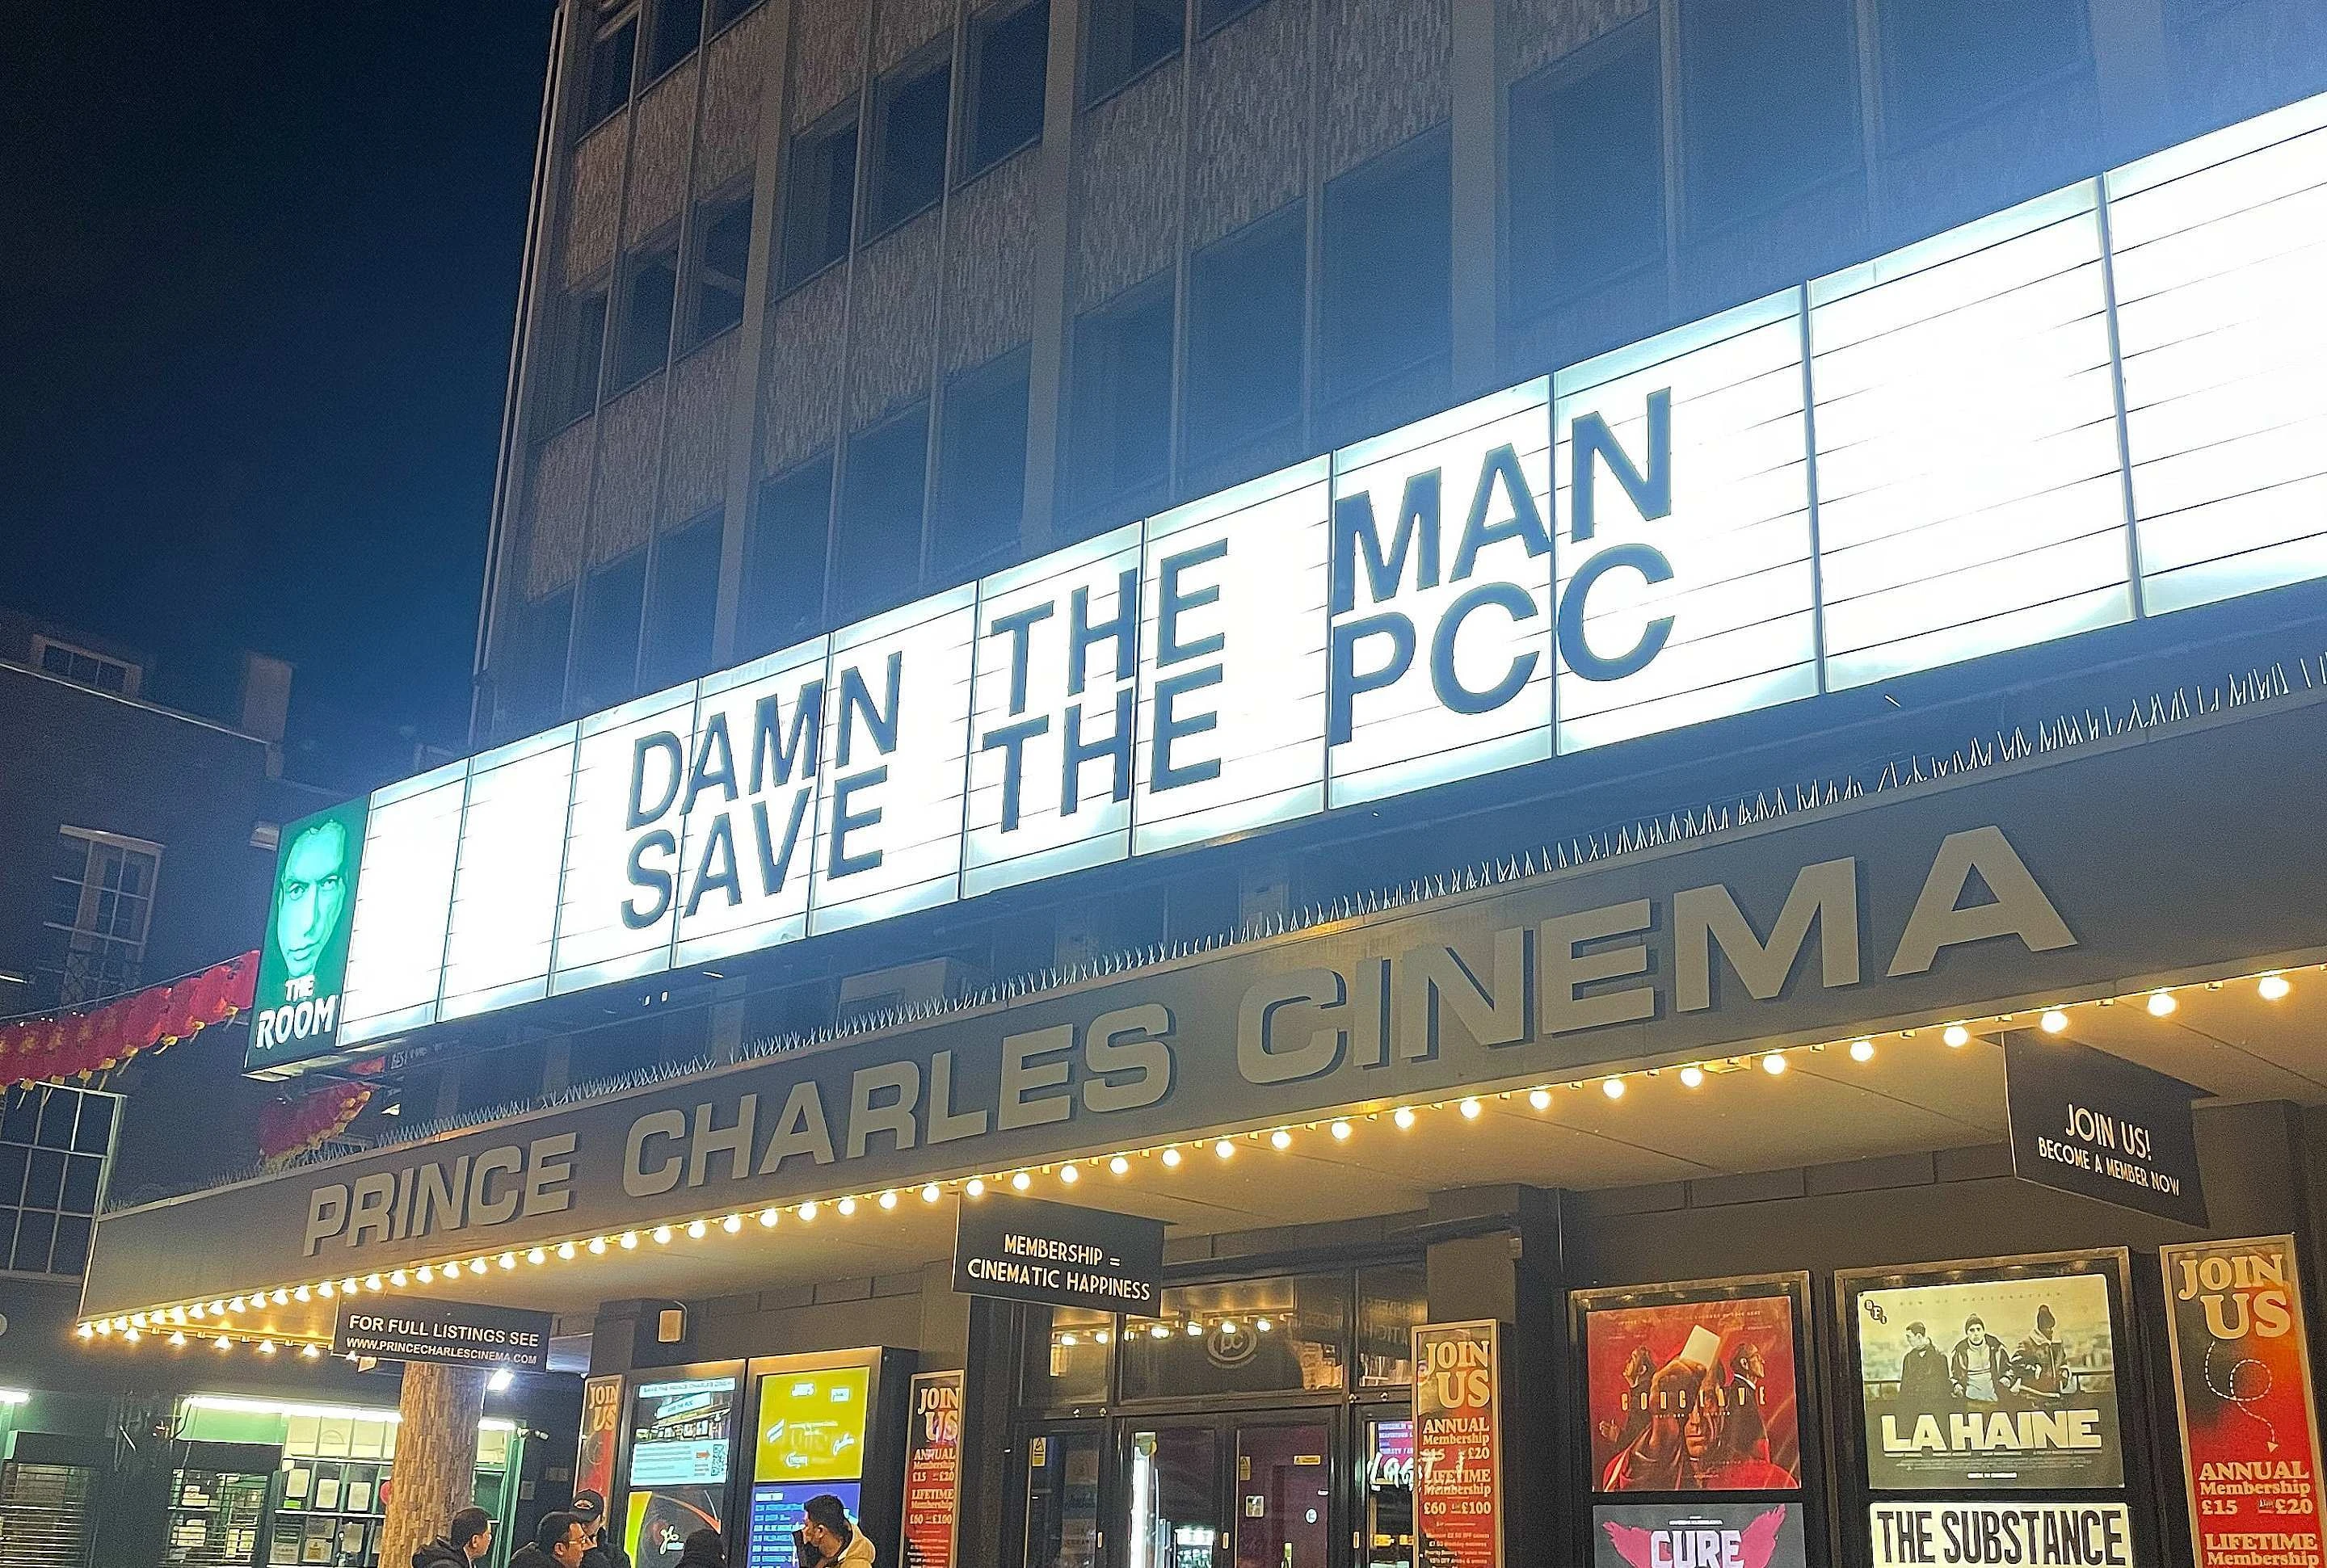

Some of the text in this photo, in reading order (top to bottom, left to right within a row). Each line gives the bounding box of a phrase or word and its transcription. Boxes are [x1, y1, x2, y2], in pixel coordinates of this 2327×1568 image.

[625, 386, 1672, 830] DAMN THE MAN
[621, 543, 1676, 929] SAVE THE PCC
[284, 974, 315, 1002] THE
[255, 994, 336, 1050] ROOM
[303, 825, 2078, 1257] PRINCE CHARLES CINEMA
[2065, 1103, 2152, 1162] JOIN US!
[2038, 1136, 2180, 1197] BECOME A MEMBER NOW
[1004, 1234, 1104, 1267] MEMBERSHIP
[967, 1258, 1151, 1301] CINEMATIC HAPPINESS
[2178, 1254, 2283, 1301] JOIN
[2199, 1290, 2291, 1340] US
[348, 1314, 540, 1347] FOR FULL LISTINGS SEE
[346, 1337, 537, 1364] WWW.PRINCECHARLESCINEMA.COM
[1417, 1340, 1490, 1386] JOIN
[589, 1383, 619, 1409] JOIN
[917, 1387, 961, 1415] JOIN
[1436, 1369, 1491, 1409] US
[593, 1406, 616, 1431] US
[924, 1410, 959, 1441] US
[1423, 1417, 1490, 1434] ANNUAL
[1881, 1409, 2102, 1452] LA HAINE
[1423, 1432, 1490, 1446] Membership
[1467, 1446, 1490, 1460] £20
[914, 1448, 956, 1461] ANNUAL
[912, 1471, 927, 1482] £15
[939, 1471, 955, 1482] £20
[1424, 1469, 1491, 1484] LIFETIME
[2199, 1461, 2309, 1481] ANNUAL
[911, 1489, 954, 1499] LIFETIME
[1424, 1482, 1492, 1498] Membership
[2199, 1479, 2311, 1498] Membership
[910, 1514, 953, 1525] £60 £100
[1424, 1502, 1447, 1515] £60
[1461, 1501, 1492, 1515] £100
[2201, 1499, 2238, 1515] £15
[2274, 1499, 2314, 1515] £20
[1650, 1529, 1745, 1568] CURE
[1877, 1510, 2127, 1566] THE SUBSTANCE
[2204, 1533, 2318, 1551] LIFETIME
[2207, 1550, 2320, 1568] Membership
